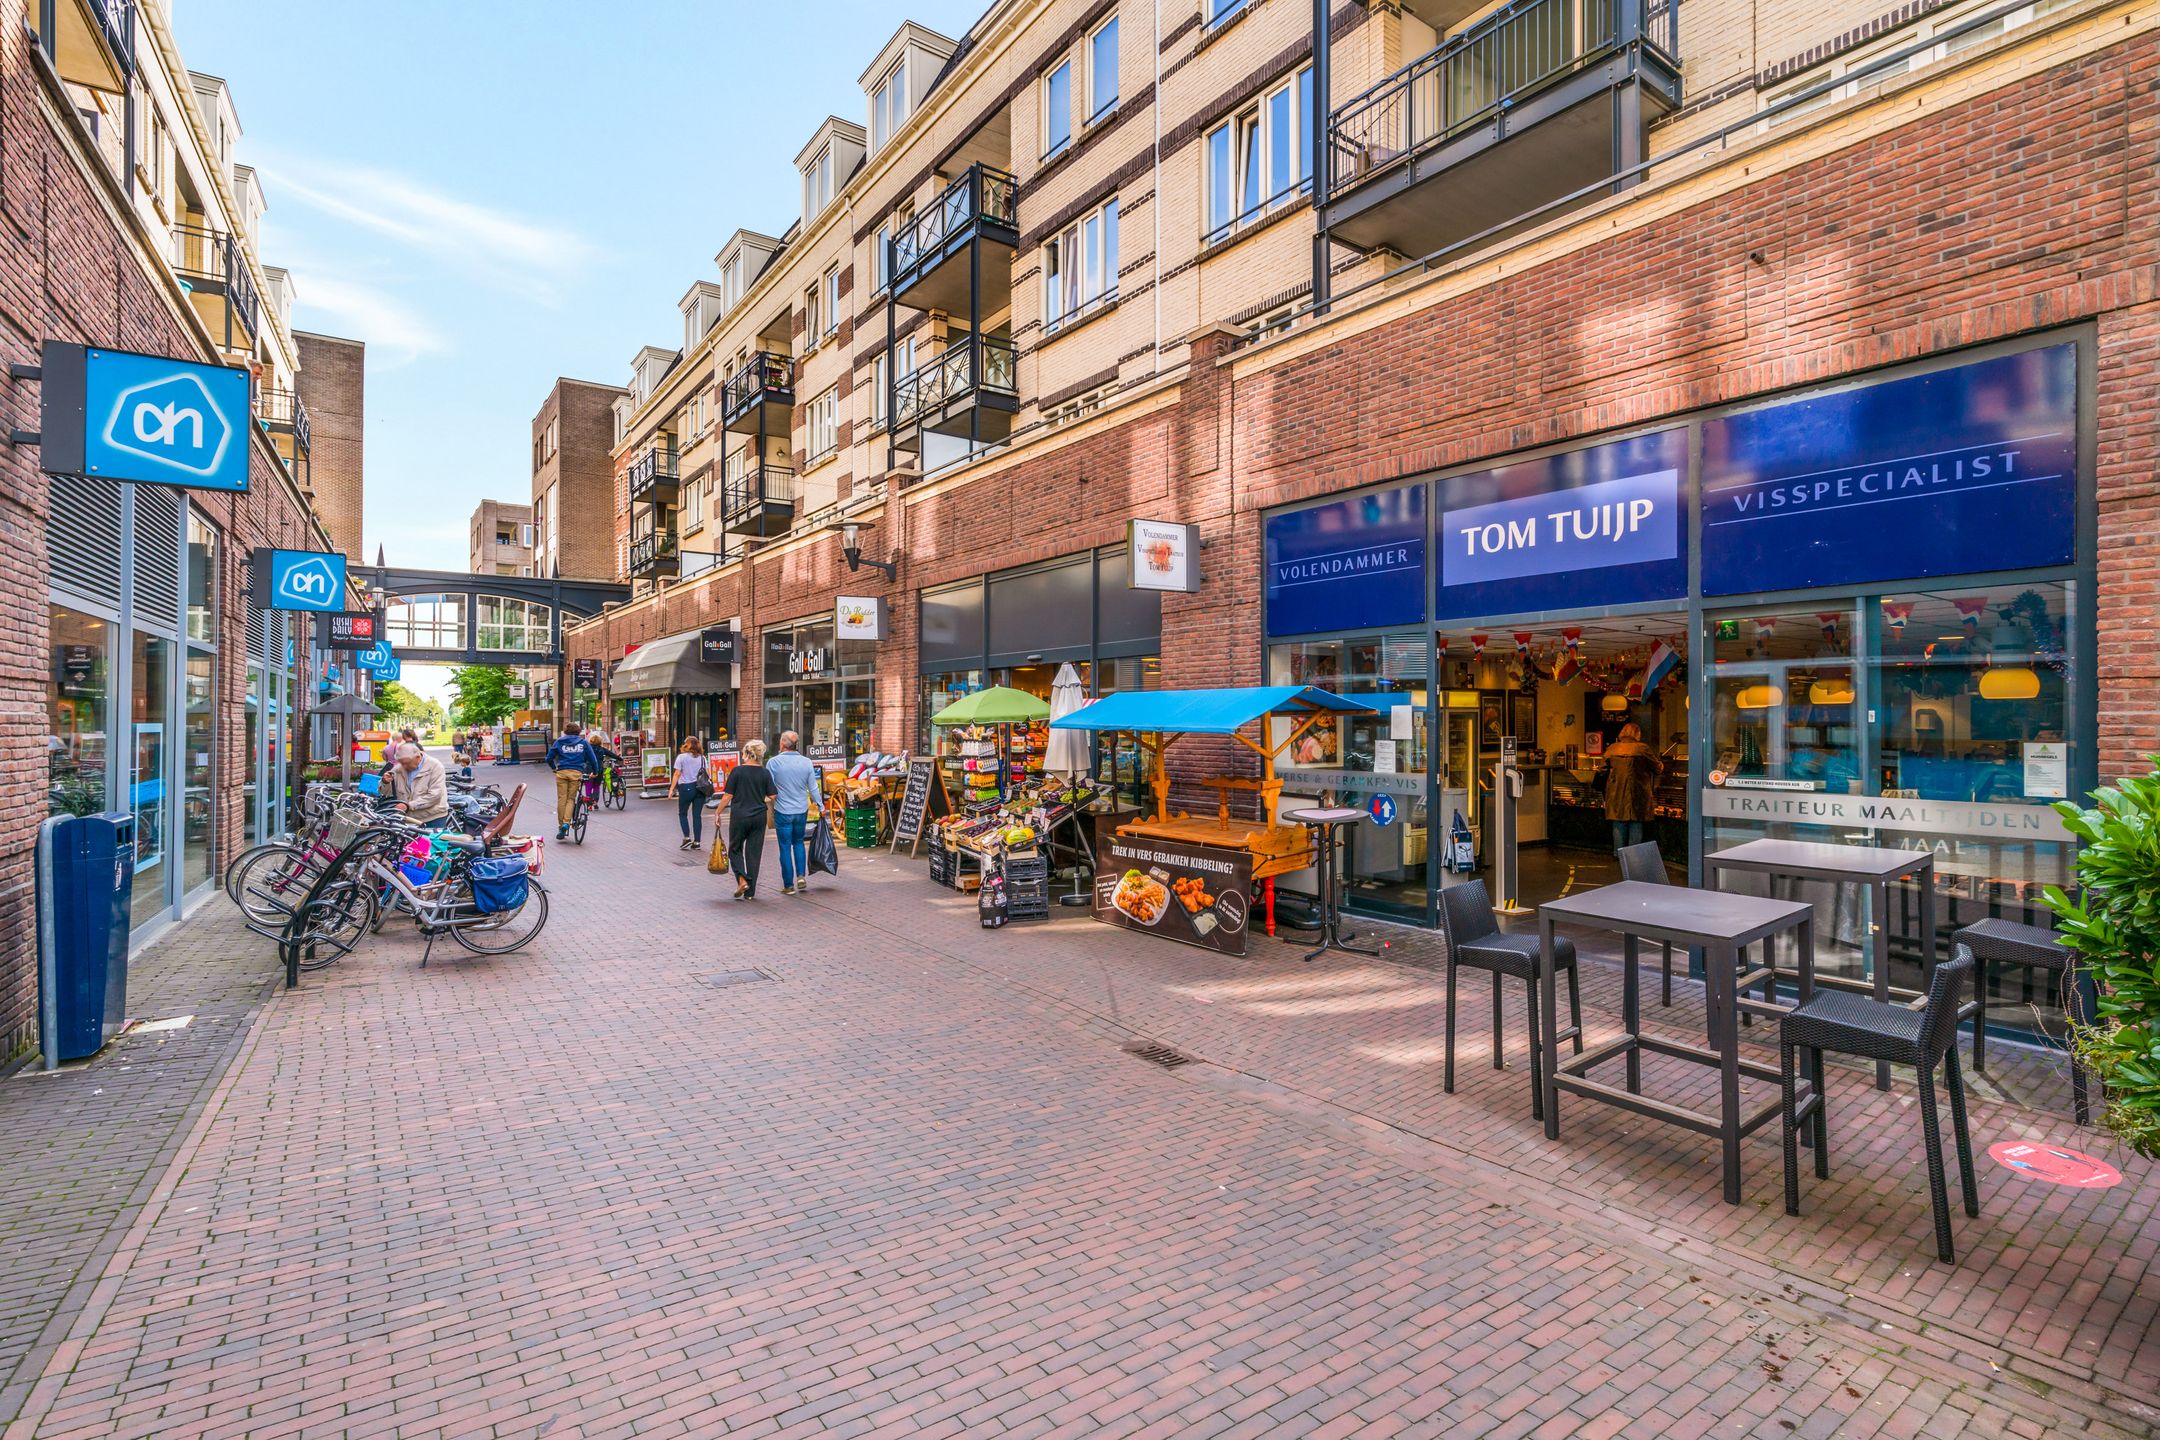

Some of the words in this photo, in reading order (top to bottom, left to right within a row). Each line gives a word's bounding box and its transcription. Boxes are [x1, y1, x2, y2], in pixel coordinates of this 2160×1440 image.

[1733, 451, 2021, 512] VISSPECIALIST
[1460, 517, 1536, 556] TOM
[1547, 499, 1654, 543] TUIJP
[1280, 549, 1408, 581] VOLENDAMMER
[332, 616, 352, 626] SUSHI
[332, 625, 352, 635] DAILY
[1276, 772, 1309, 783] VERSE
[1396, 779, 1418, 789] VIS
[1727, 797, 1844, 817] TRAITEUR
[1859, 805, 2040, 830] MAALTIJDEN
[1112, 845, 1127, 857] TREK
[1128, 848, 1136, 858] IN
[1136, 849, 1152, 861] VERS
[1153, 852, 1189, 867] GEBAKKEN
[1190, 857, 1234, 875] KIBBELING?
